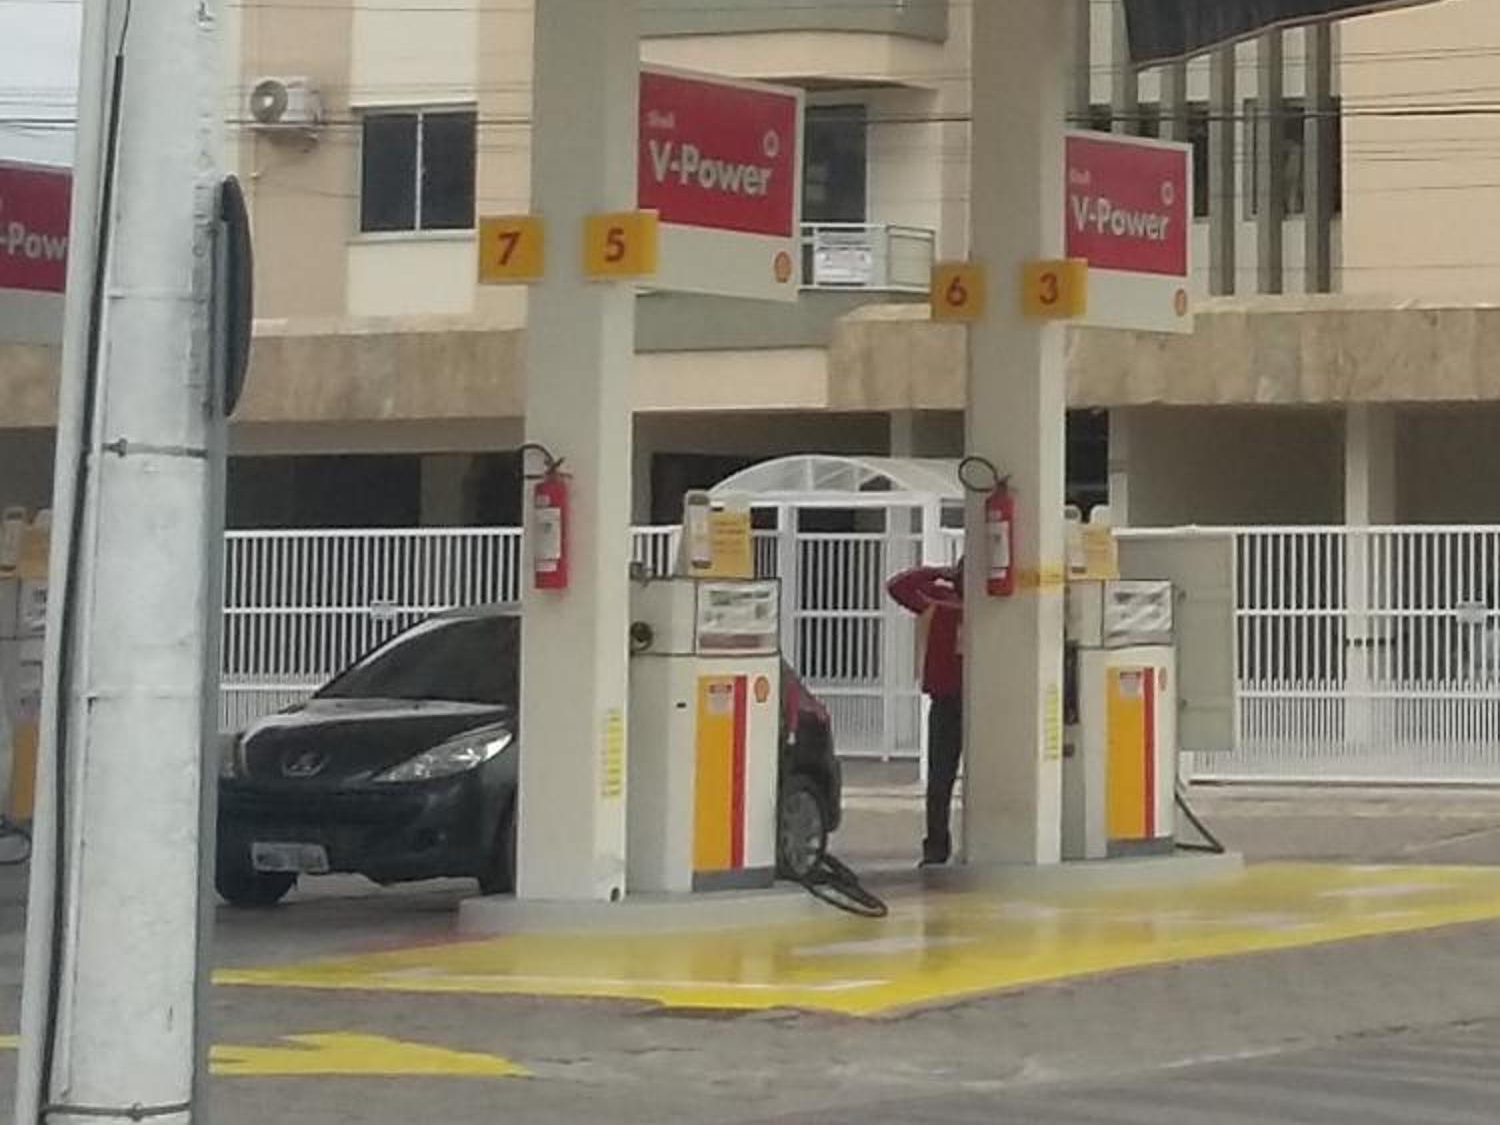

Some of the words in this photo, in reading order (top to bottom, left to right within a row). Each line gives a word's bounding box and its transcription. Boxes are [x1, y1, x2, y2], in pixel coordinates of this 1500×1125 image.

[649, 139, 773, 195] V-Power
[1071, 195, 1169, 240] V-Power
[498, 230, 522, 266] 7
[604, 226, 626, 263] 5
[945, 275, 968, 307] 6
[1038, 271, 1059, 305] 3
